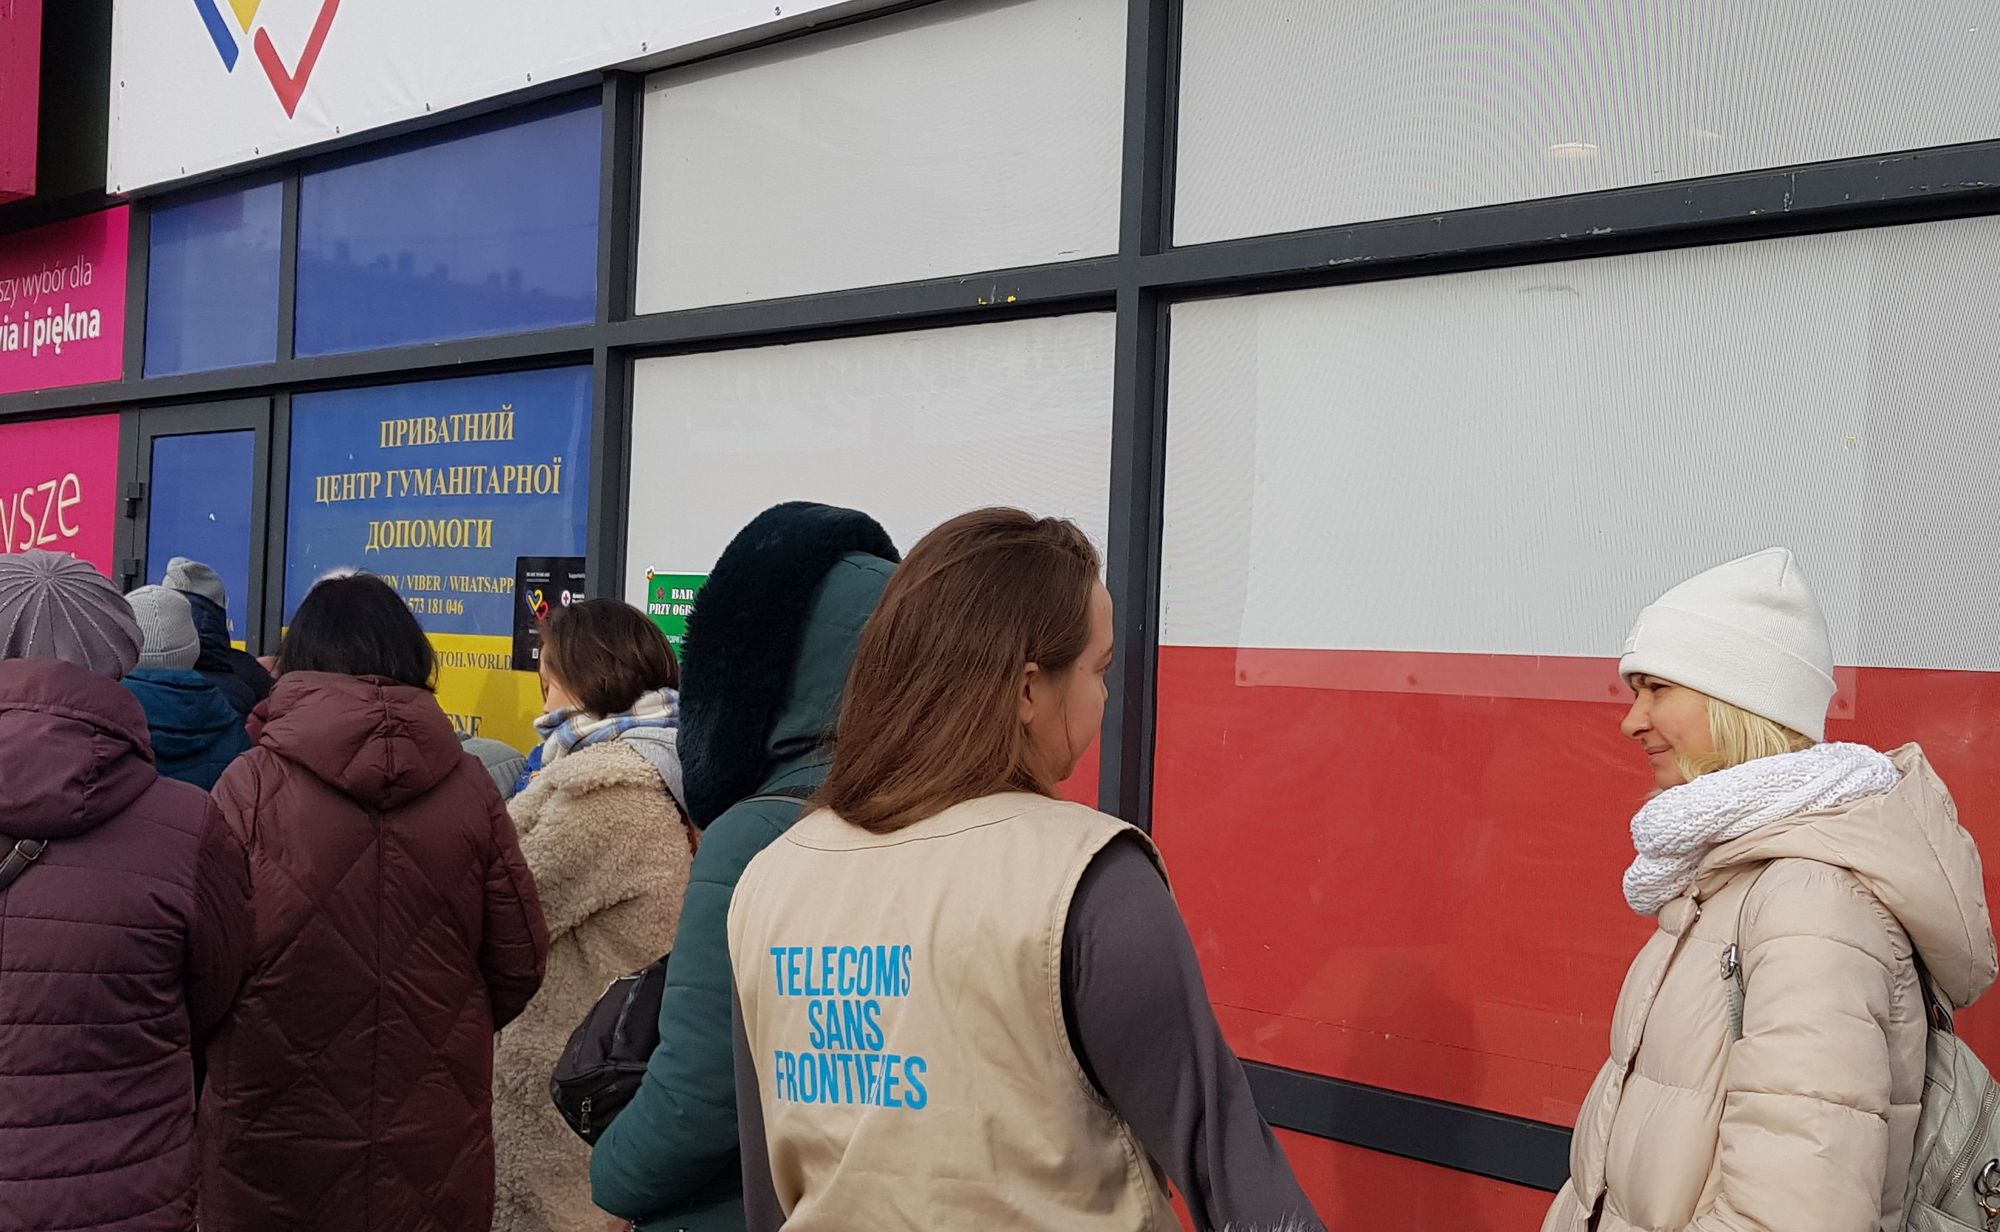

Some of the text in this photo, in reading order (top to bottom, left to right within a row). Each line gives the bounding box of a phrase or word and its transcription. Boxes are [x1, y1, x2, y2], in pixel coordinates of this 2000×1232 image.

[22, 260, 68, 305] wybór
[70, 254, 93, 289] dla
[23, 310, 29, 349] i
[32, 302, 101, 357] piękna
[379, 403, 516, 448] ПРИВАТНИЙ
[314, 456, 562, 508] ЦЕНТР ГУМАНІТАРНОЇ
[364, 519, 494, 555] ДОПОМОГИ
[406, 575, 442, 591] VIBER
[449, 575, 515, 594] WHATSAPP
[671, 588, 694, 600] BAR
[427, 597, 443, 615] 181
[446, 598, 465, 616] 046
[648, 603, 672, 616] PRZY
[436, 651, 513, 671] TOH.WORLD
[770, 944, 913, 997] TELECOMS
[808, 999, 885, 1051] SANS
